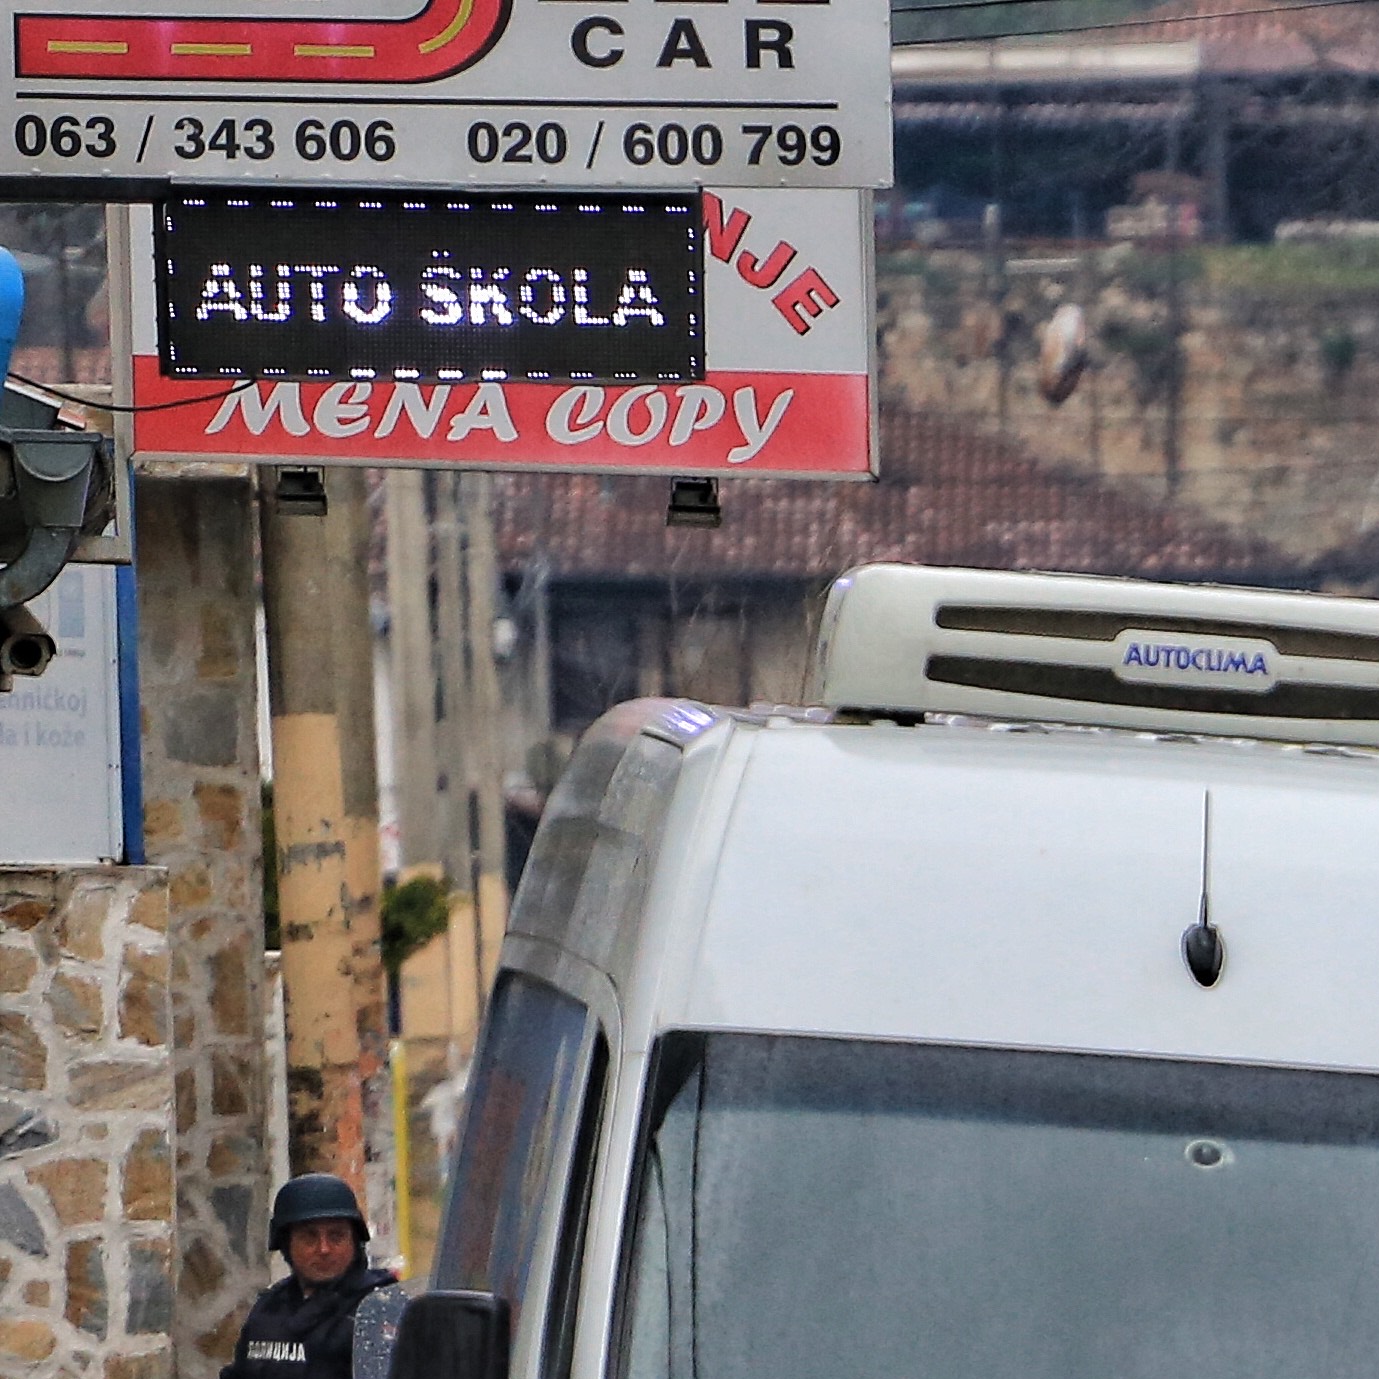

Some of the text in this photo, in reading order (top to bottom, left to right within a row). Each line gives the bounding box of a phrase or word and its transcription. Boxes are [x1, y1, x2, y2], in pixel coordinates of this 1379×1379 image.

[571, 16, 795, 68] CAR
[14, 114, 117, 157] 063
[174, 117, 275, 160] 343
[295, 118, 396, 161] 606
[467, 121, 567, 165] 020
[623, 123, 723, 166] 600
[742, 125, 841, 167] 799
[196, 248, 665, 327] AUTO ŠKOLA
[205, 379, 796, 463] MENA COPY
[1123, 643, 1268, 675] AUTOCLIMA
